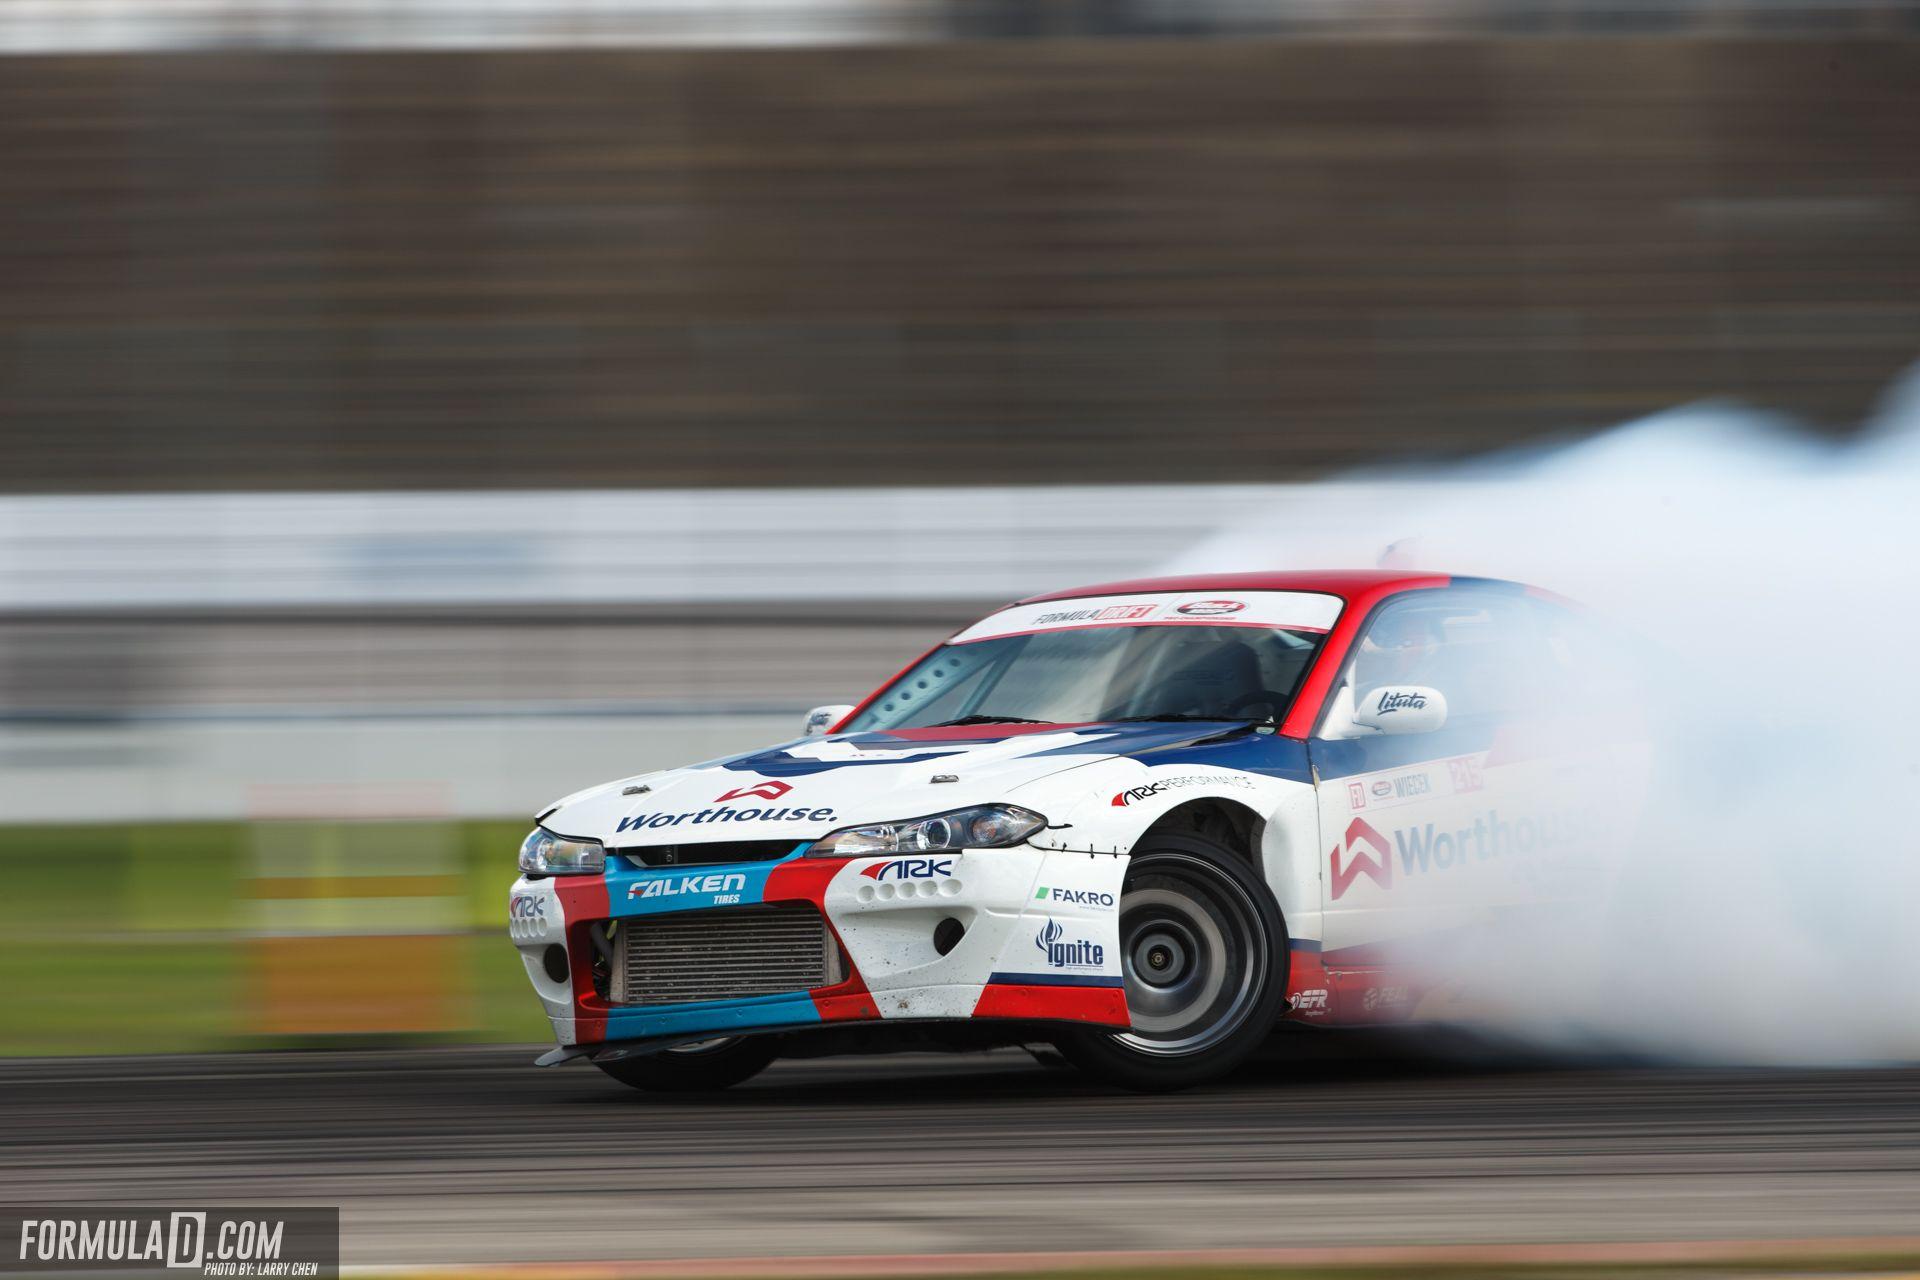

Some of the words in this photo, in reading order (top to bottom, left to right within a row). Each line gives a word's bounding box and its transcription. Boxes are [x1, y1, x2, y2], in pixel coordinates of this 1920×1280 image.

[616, 806, 839, 833] Worthouse.
[860, 859, 953, 881] ARK
[627, 873, 746, 900] FALKEN
[1052, 888, 1115, 907] FAKRO
[713, 893, 741, 905] TIRES
[1048, 938, 1104, 968] ignite
